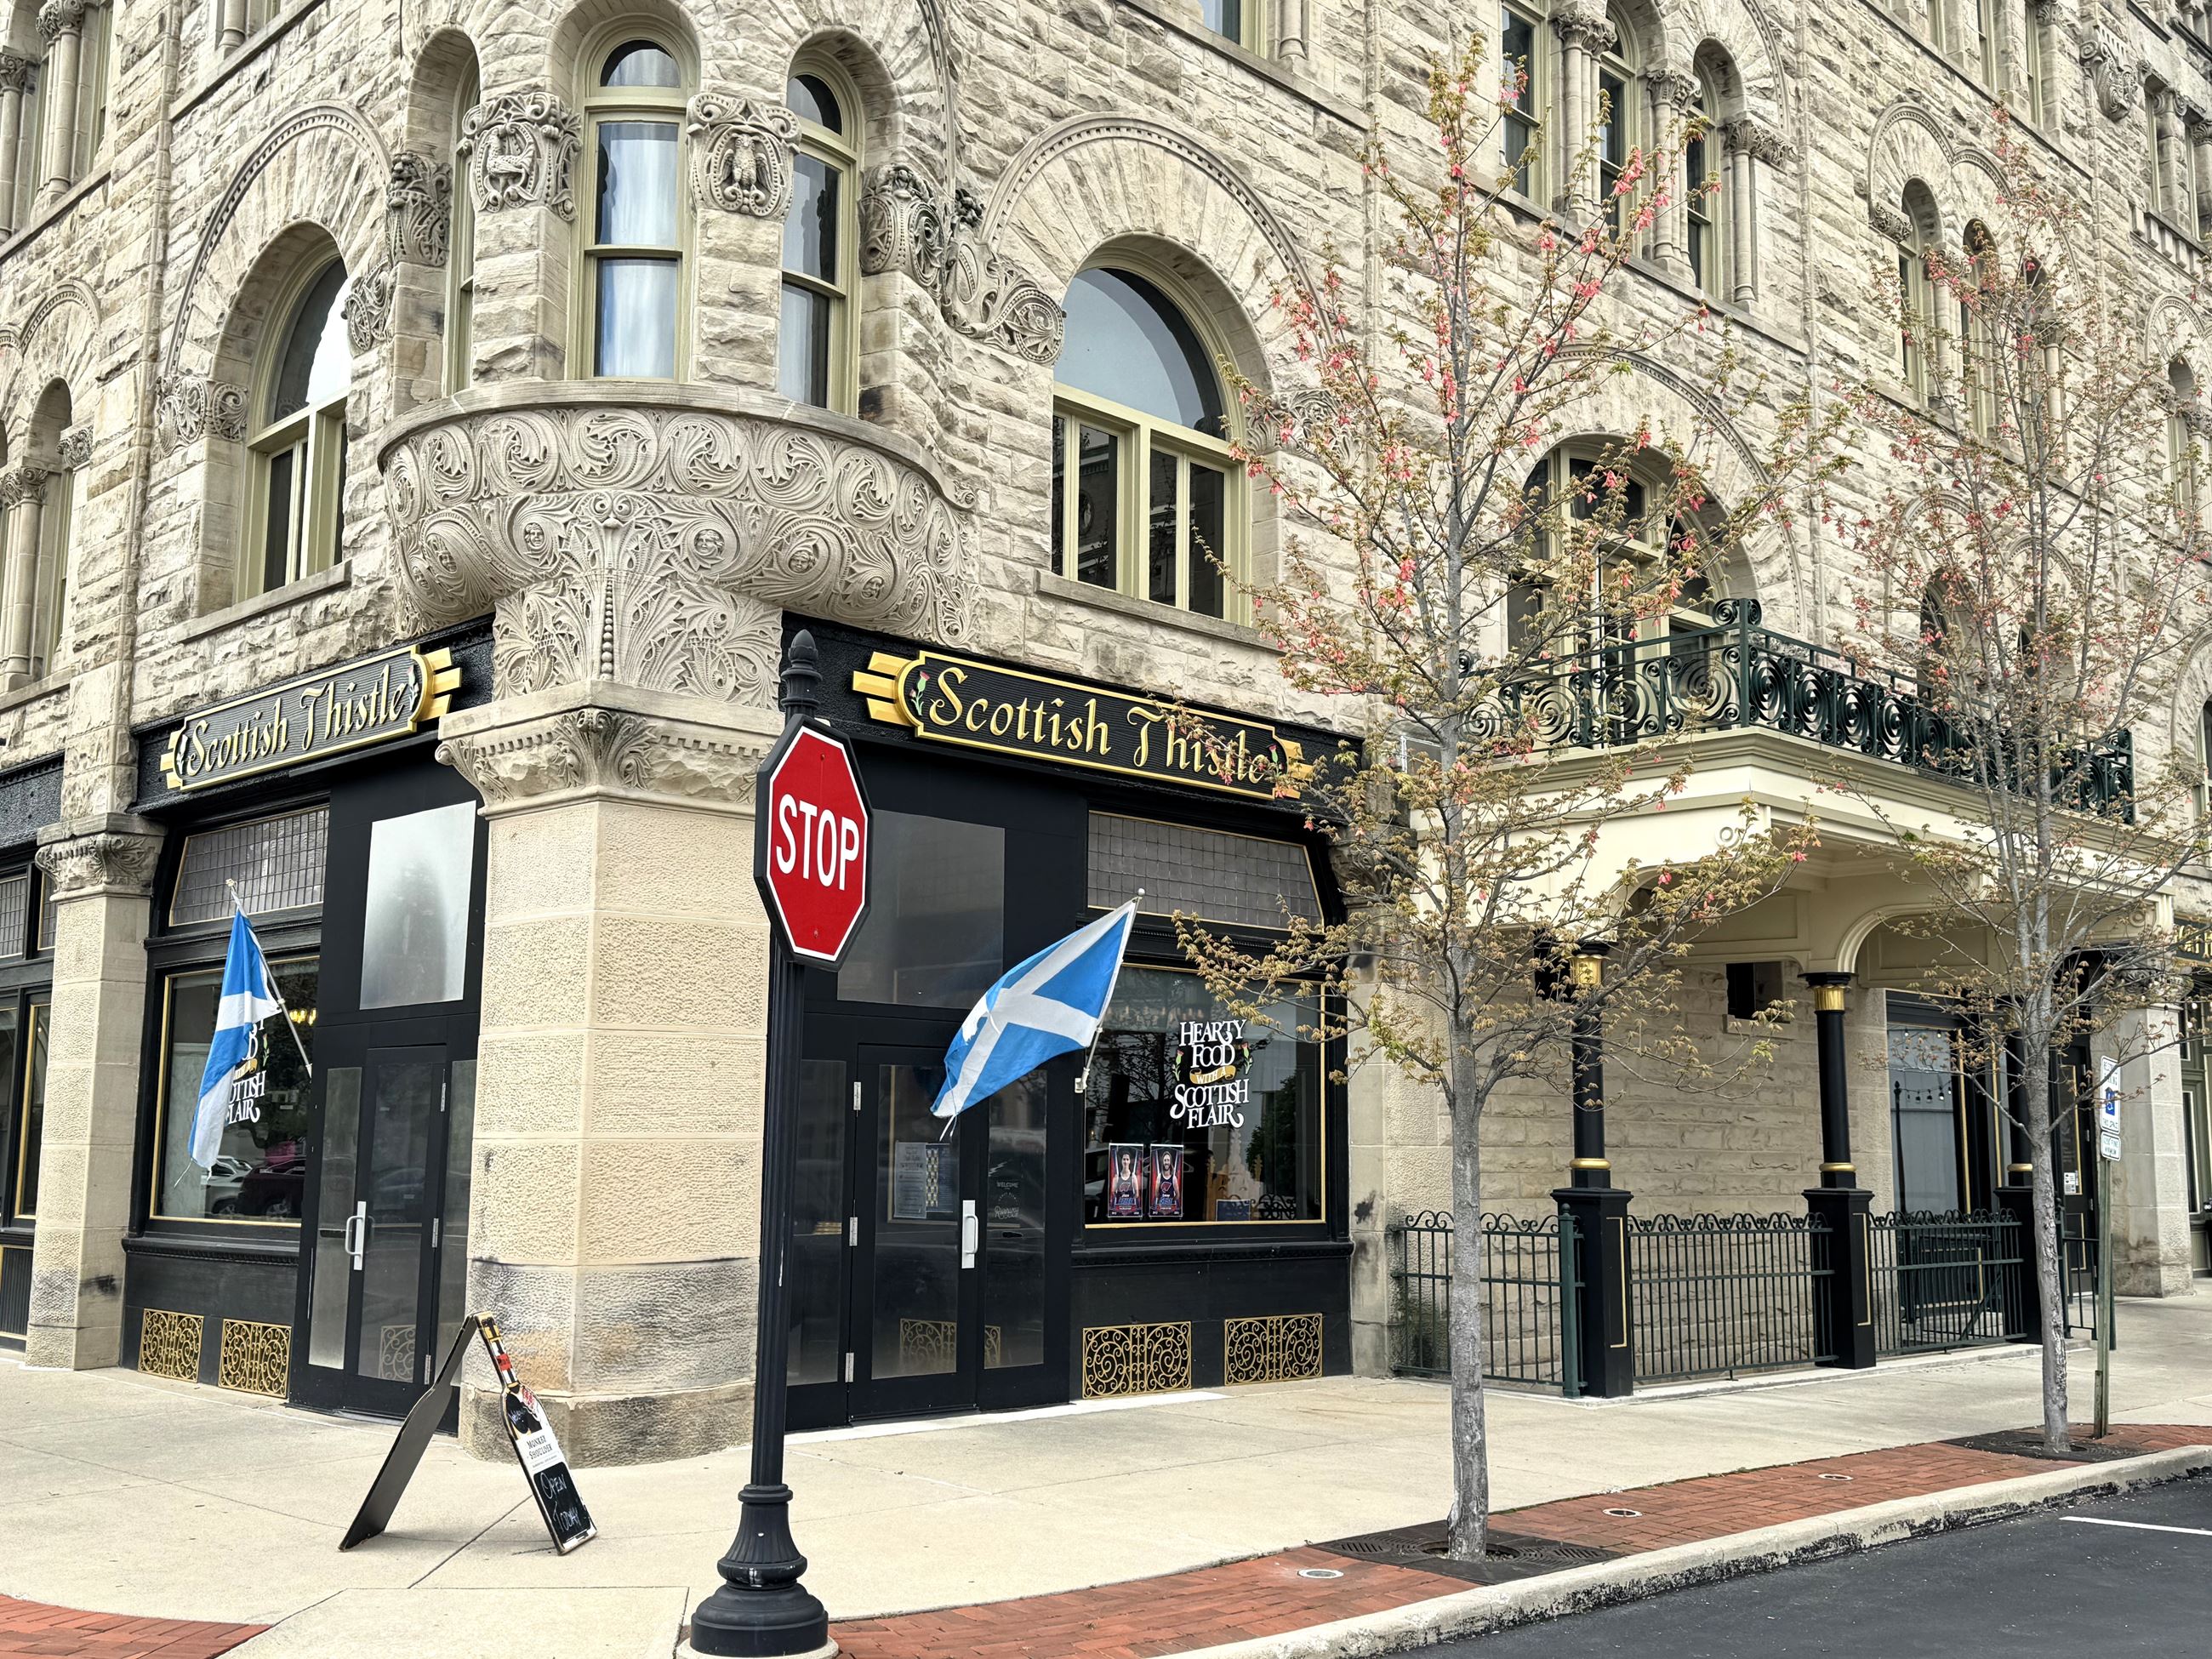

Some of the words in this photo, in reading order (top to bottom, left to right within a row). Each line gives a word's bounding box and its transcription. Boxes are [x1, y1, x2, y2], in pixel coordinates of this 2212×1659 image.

[187, 698, 290, 778] Scottish
[300, 664, 408, 752] Thistle
[928, 666, 1111, 756] Scottish
[776, 793, 860, 892] STOP
[1179, 1018, 1247, 1046] HEARTY
[1190, 1044, 1235, 1069] FOOD
[1196, 1072, 1218, 1085] WITH
[1221, 1066, 1227, 1076] A
[226, 1098, 261, 1124] LAIR
[1170, 1079, 1250, 1120] SCOTTISH
[1187, 1103, 1245, 1130] FLAIR
